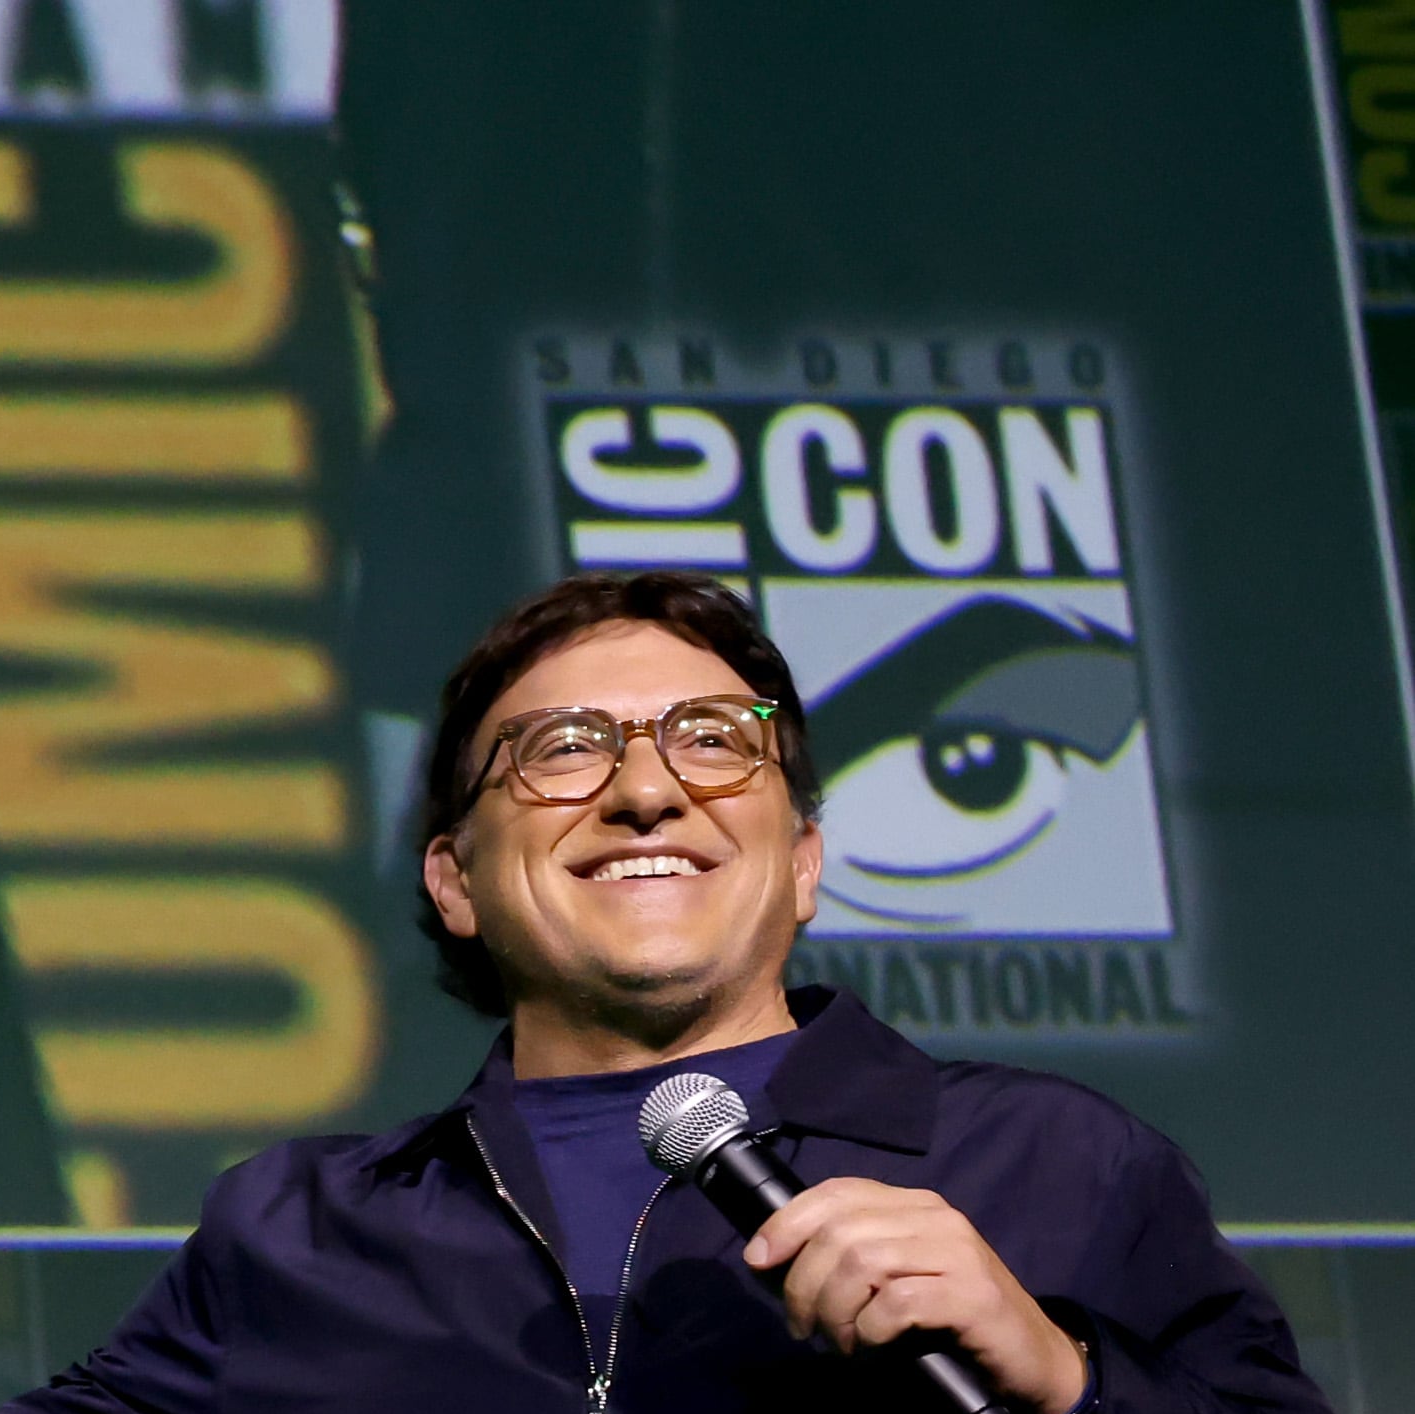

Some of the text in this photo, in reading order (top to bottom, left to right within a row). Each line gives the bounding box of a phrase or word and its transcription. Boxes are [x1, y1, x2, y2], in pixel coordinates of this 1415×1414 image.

[536, 338, 1104, 390] SAN DIEGO
[561, 406, 749, 570] IC
[759, 403, 1121, 578] CON
